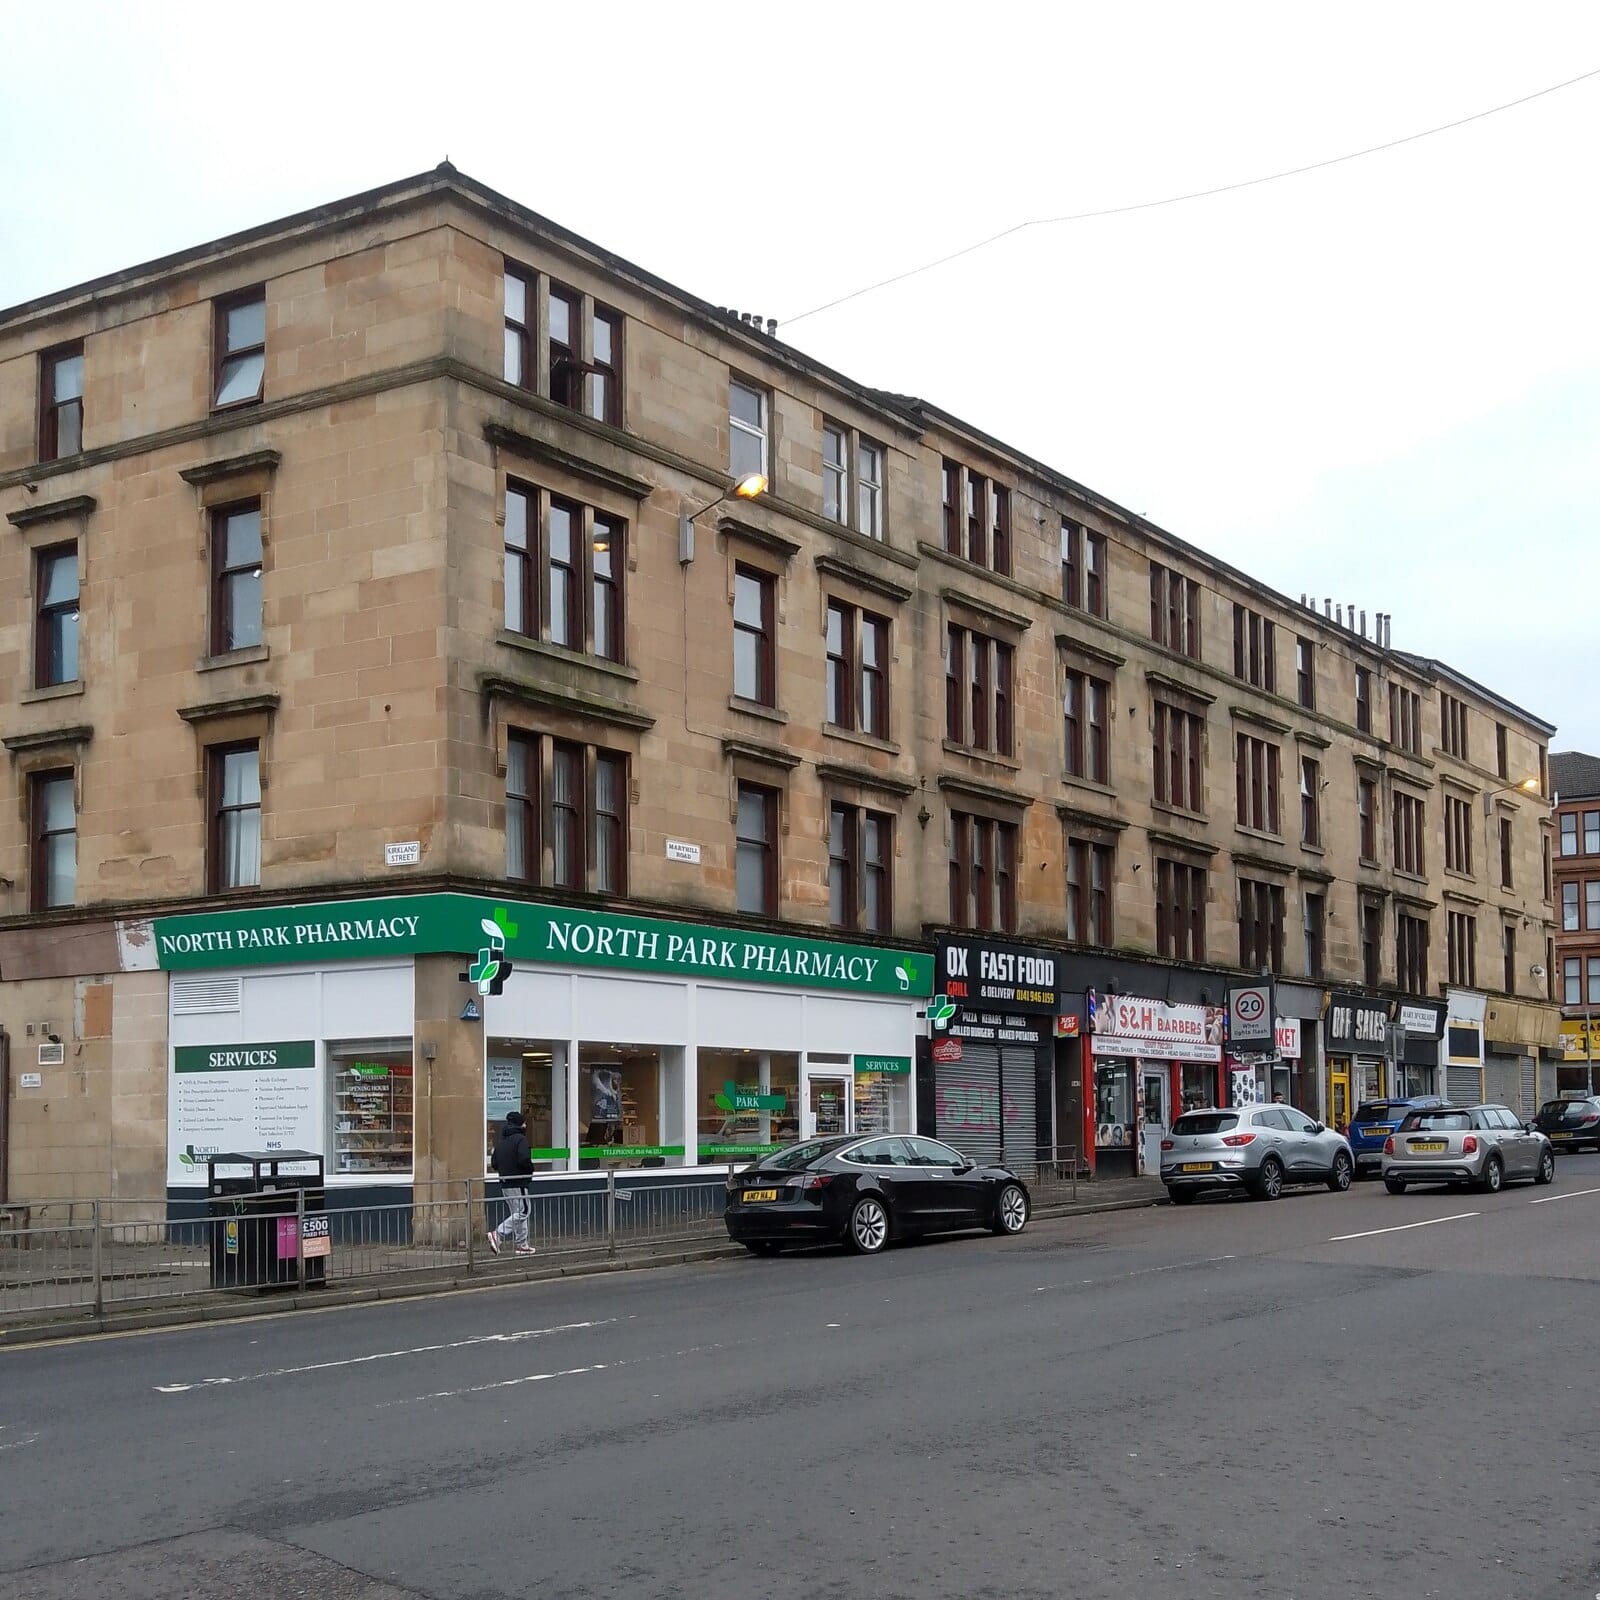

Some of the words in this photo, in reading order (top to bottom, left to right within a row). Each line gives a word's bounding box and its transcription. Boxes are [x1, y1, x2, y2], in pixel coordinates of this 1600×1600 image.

[387, 845, 417, 854] KIRKLAND
[668, 843, 698, 853] MARYHILL
[391, 853, 414, 862] STREET
[676, 851, 692, 860] ROAD
[161, 930, 233, 954] NORTH
[236, 926, 291, 949] PARK
[295, 916, 419, 944] PHARMACY
[546, 921, 659, 960] NORTH
[666, 935, 736, 968] PARK
[741, 944, 878, 982] PHARMACY
[980, 950, 1015, 982] FAST
[1018, 956, 1055, 986] FOOD
[946, 981, 969, 997] GRILL
[987, 985, 1015, 1000] DELIVERY
[1240, 999, 1261, 1013] 20
[962, 1012, 978, 1023] PIZZA
[981, 1013, 1002, 1025] KEBABS
[1005, 1015, 1026, 1027] CURRIES
[1332, 1006, 1352, 1040] OFF
[1355, 1009, 1388, 1042] SALES
[970, 1026, 995, 1038] BURGERS
[1157, 1017, 1202, 1036] BARBERS
[209, 1050, 277, 1067] SERVICES
[865, 1061, 899, 1071] SERVICES
[736, 1096, 760, 1107] PARK
[194, 1145, 220, 1153] NORTH
[266, 1141, 282, 1149] NHS
[303, 1220, 329, 1232] £500
